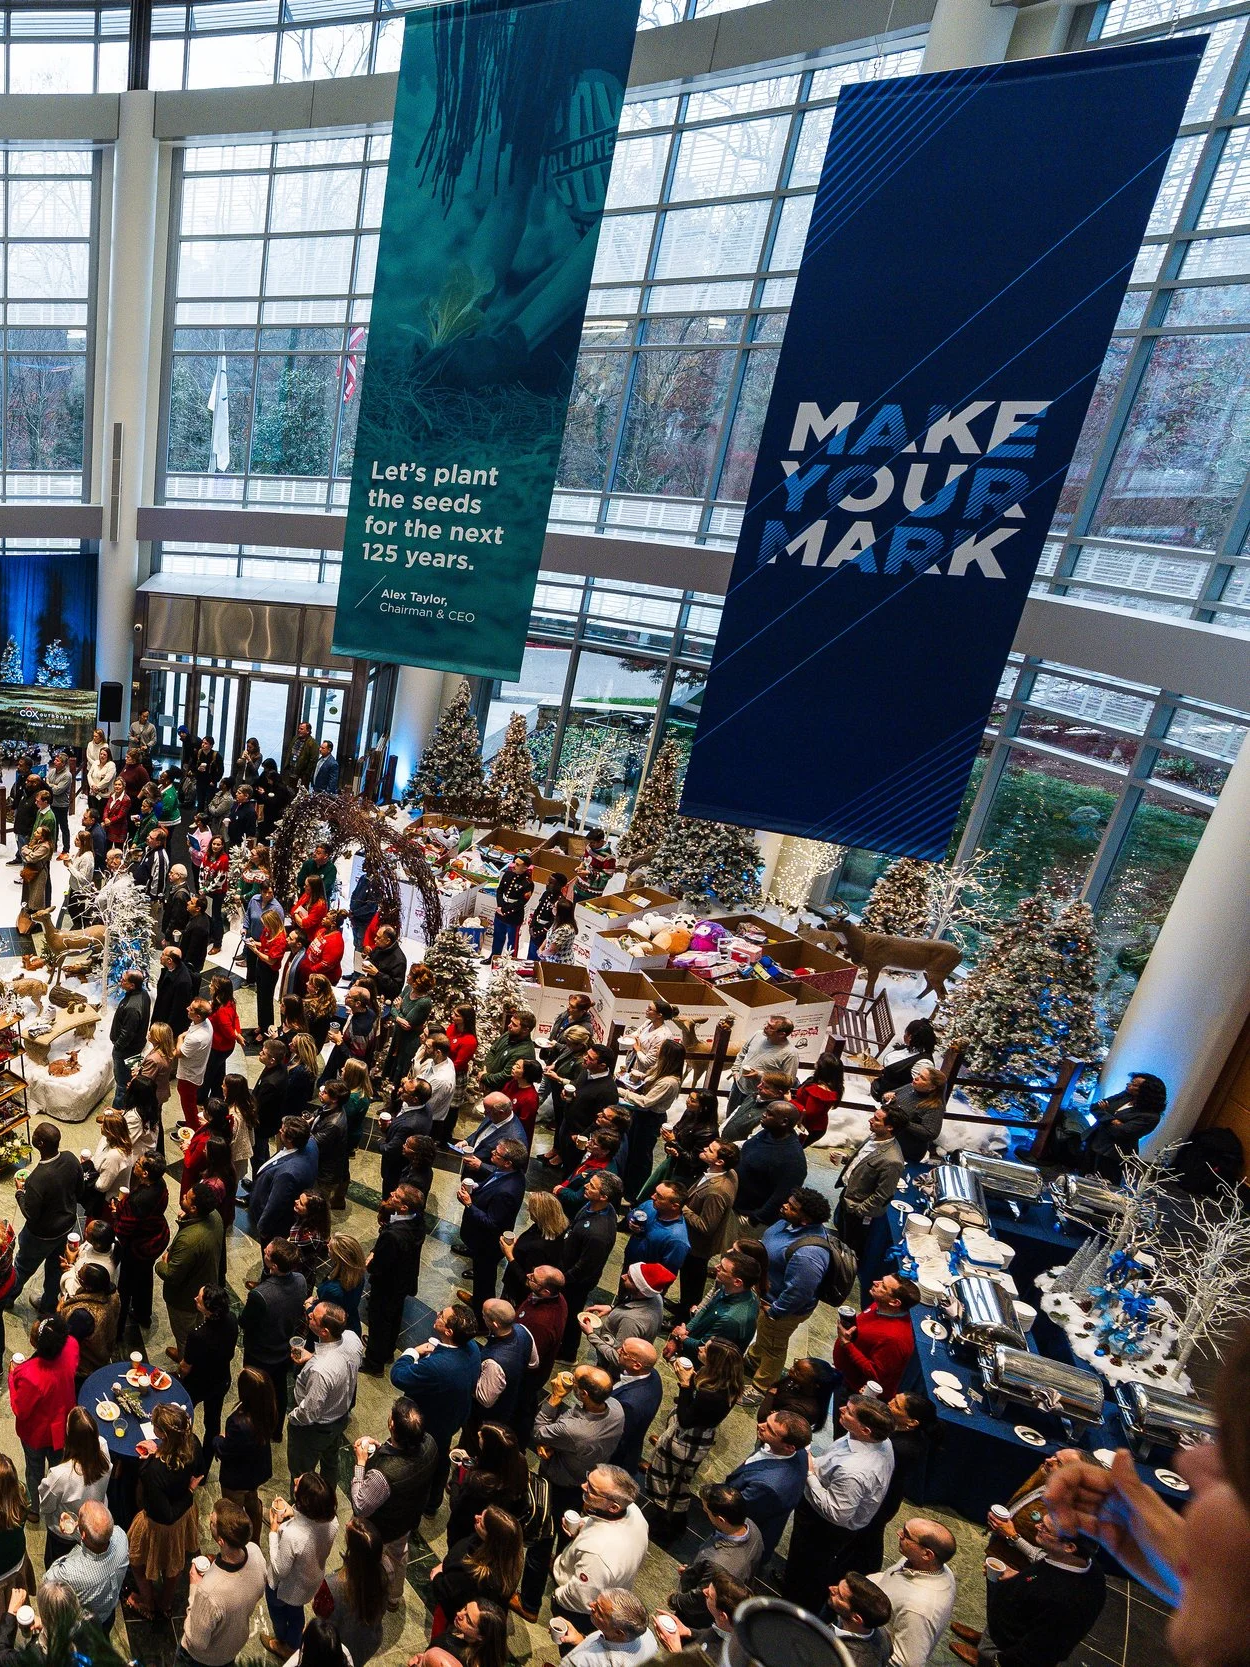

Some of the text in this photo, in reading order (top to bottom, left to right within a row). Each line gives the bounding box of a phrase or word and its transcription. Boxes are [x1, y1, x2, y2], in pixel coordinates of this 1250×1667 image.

[788, 400, 1054, 458] MAKE
[371, 460, 499, 487] Let’s plant
[368, 488, 482, 514] the seeds
[780, 460, 1030, 519] YOUR
[364, 515, 505, 545] for the next
[362, 542, 475, 571] 125 years.
[758, 519, 1021, 579] MARK
[381, 589, 448, 607] Alex Taylor,
[379, 602, 475, 623] Chairman & CEO
[19, 709, 40, 720] COX
